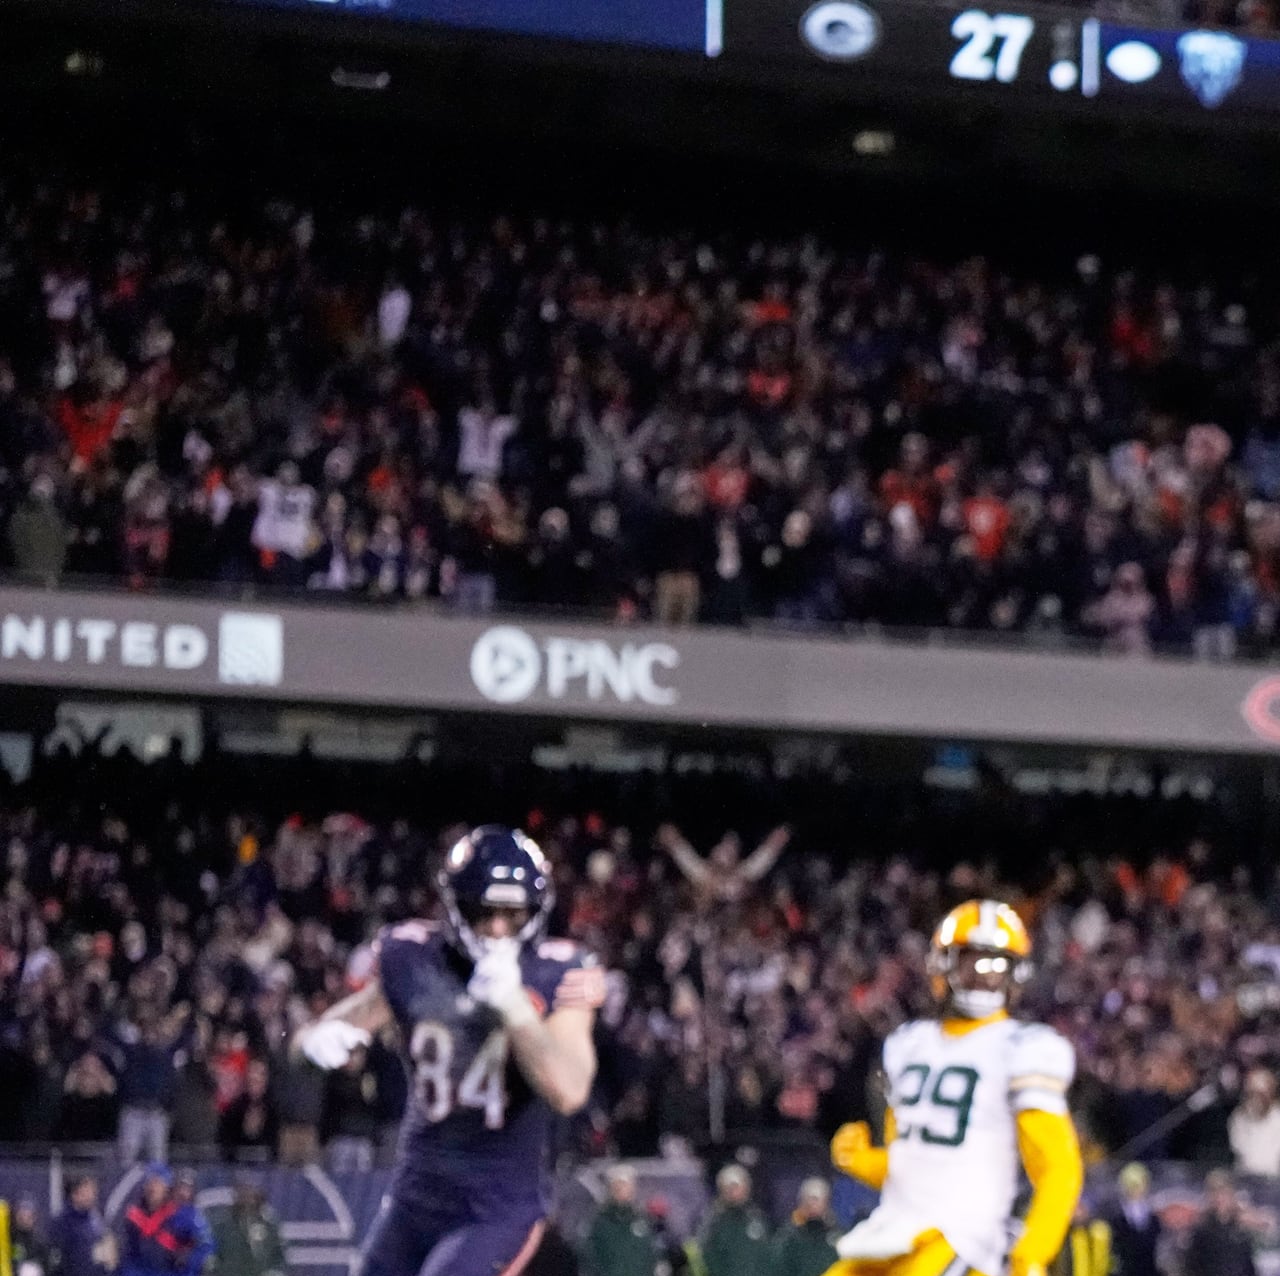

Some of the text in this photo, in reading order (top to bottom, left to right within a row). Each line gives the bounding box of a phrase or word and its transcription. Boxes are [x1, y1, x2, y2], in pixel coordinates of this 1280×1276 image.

[949, 10, 1034, 82] 27
[2, 613, 208, 670] NITED
[547, 635, 680, 705] PNC
[410, 1021, 509, 1129] 84
[899, 1064, 980, 1146] 29
